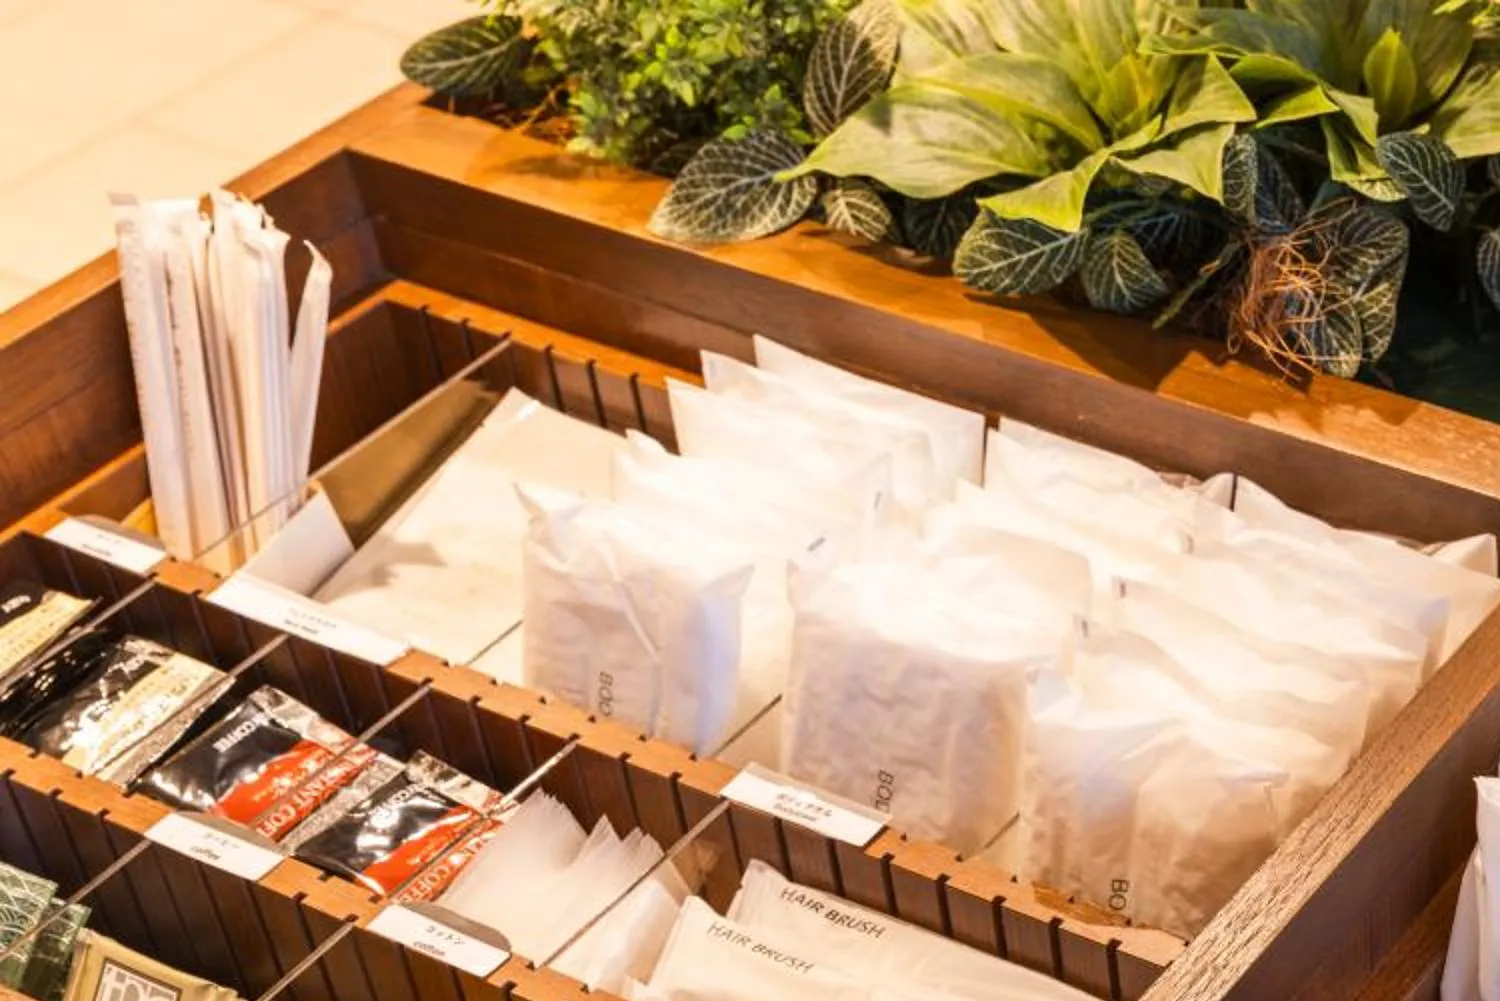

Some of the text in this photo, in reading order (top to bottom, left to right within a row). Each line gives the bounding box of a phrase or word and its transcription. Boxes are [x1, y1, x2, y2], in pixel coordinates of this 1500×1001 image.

[780, 886, 886, 939] HAIR BRUSH
[706, 919, 815, 974] HAIR BRUSH
